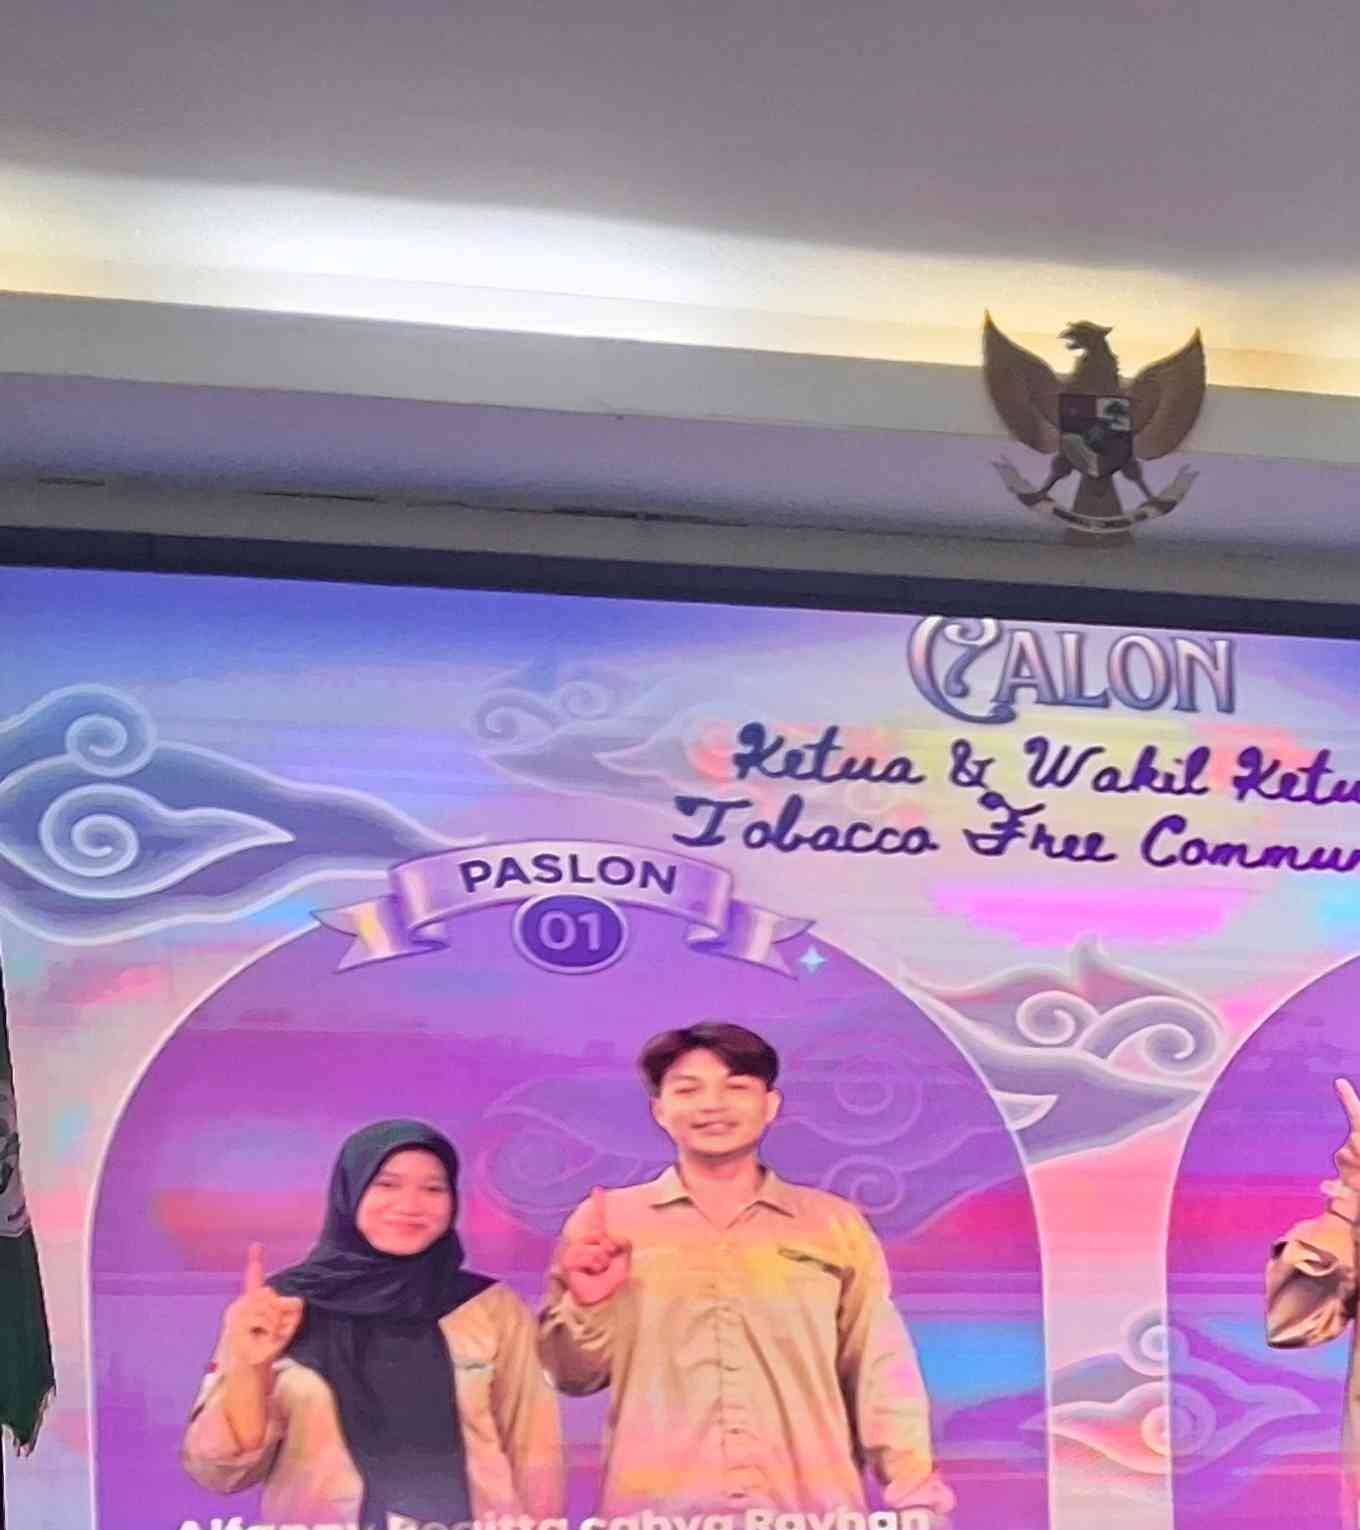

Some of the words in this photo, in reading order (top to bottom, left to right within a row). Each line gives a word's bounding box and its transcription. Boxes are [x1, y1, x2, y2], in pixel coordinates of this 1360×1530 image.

[907, 615, 1236, 724] CALON
[732, 722, 926, 785] Ketua
[949, 739, 995, 790] &
[1024, 736, 1211, 795] Wakil
[673, 794, 939, 854] Tobacco
[962, 791, 1117, 862] Free
[459, 853, 676, 894] PASLON
[540, 910, 601, 950] 01
